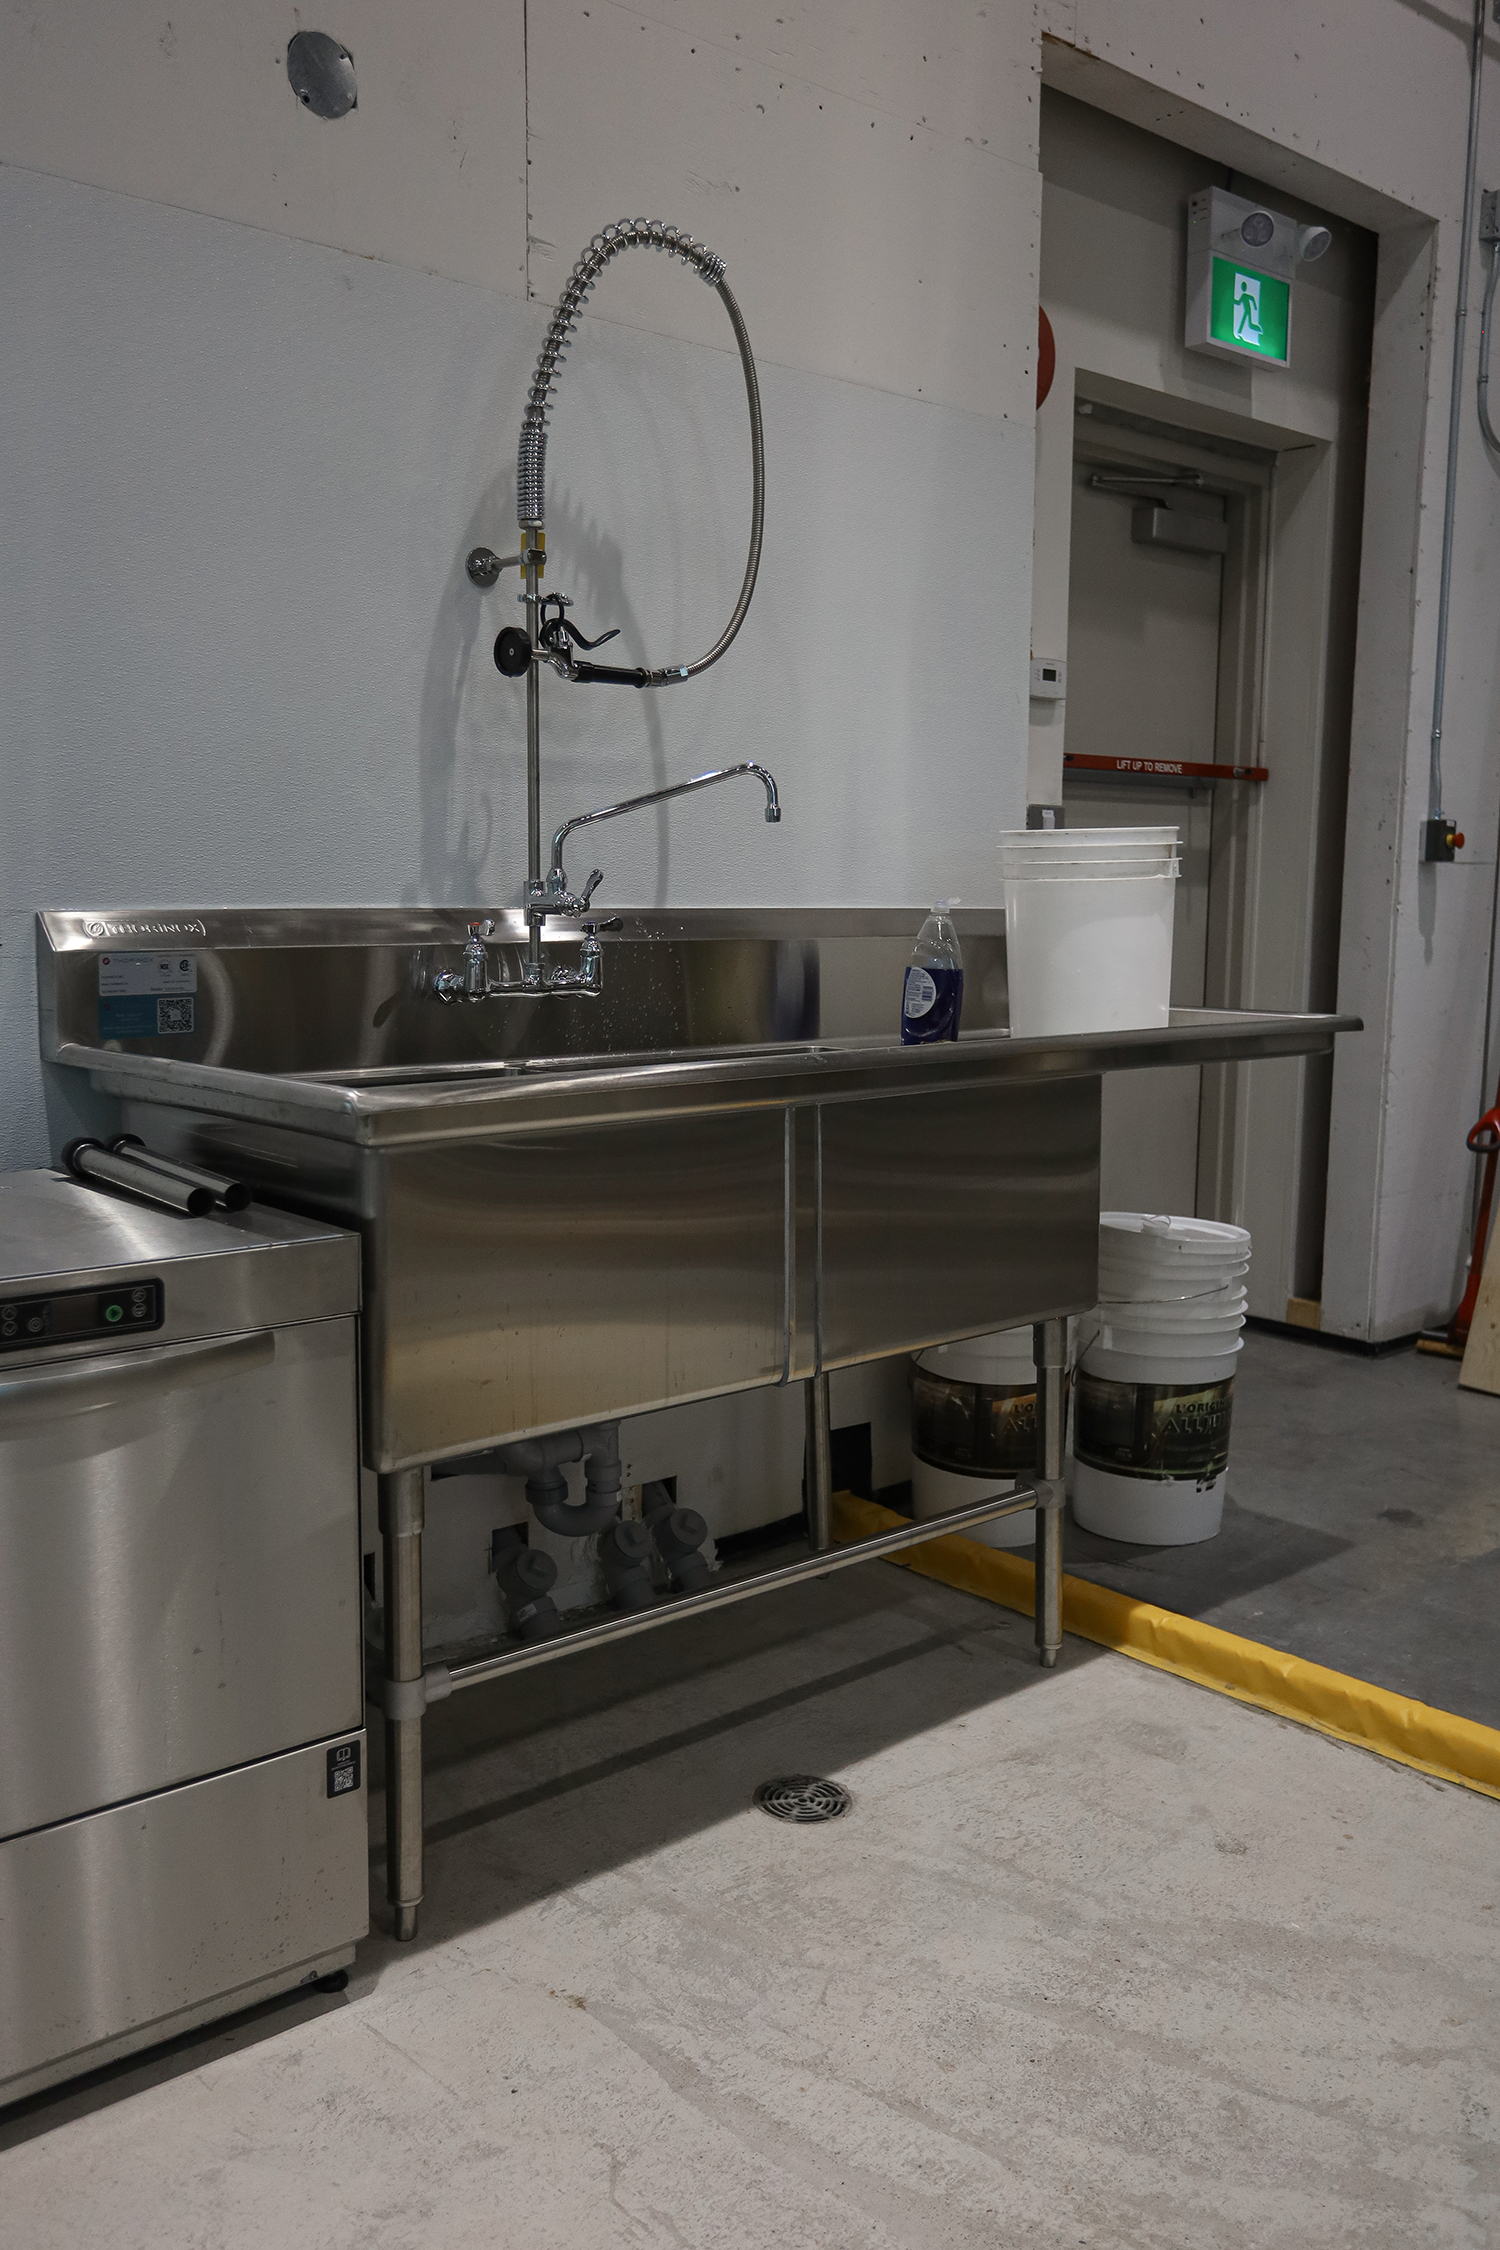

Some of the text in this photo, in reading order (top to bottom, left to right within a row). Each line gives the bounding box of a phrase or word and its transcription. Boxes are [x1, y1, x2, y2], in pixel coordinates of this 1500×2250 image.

[1116, 760, 1183, 774] LIFT UP TO REMOVE
[1175, 1400, 1226, 1414] L'ORIGIN
